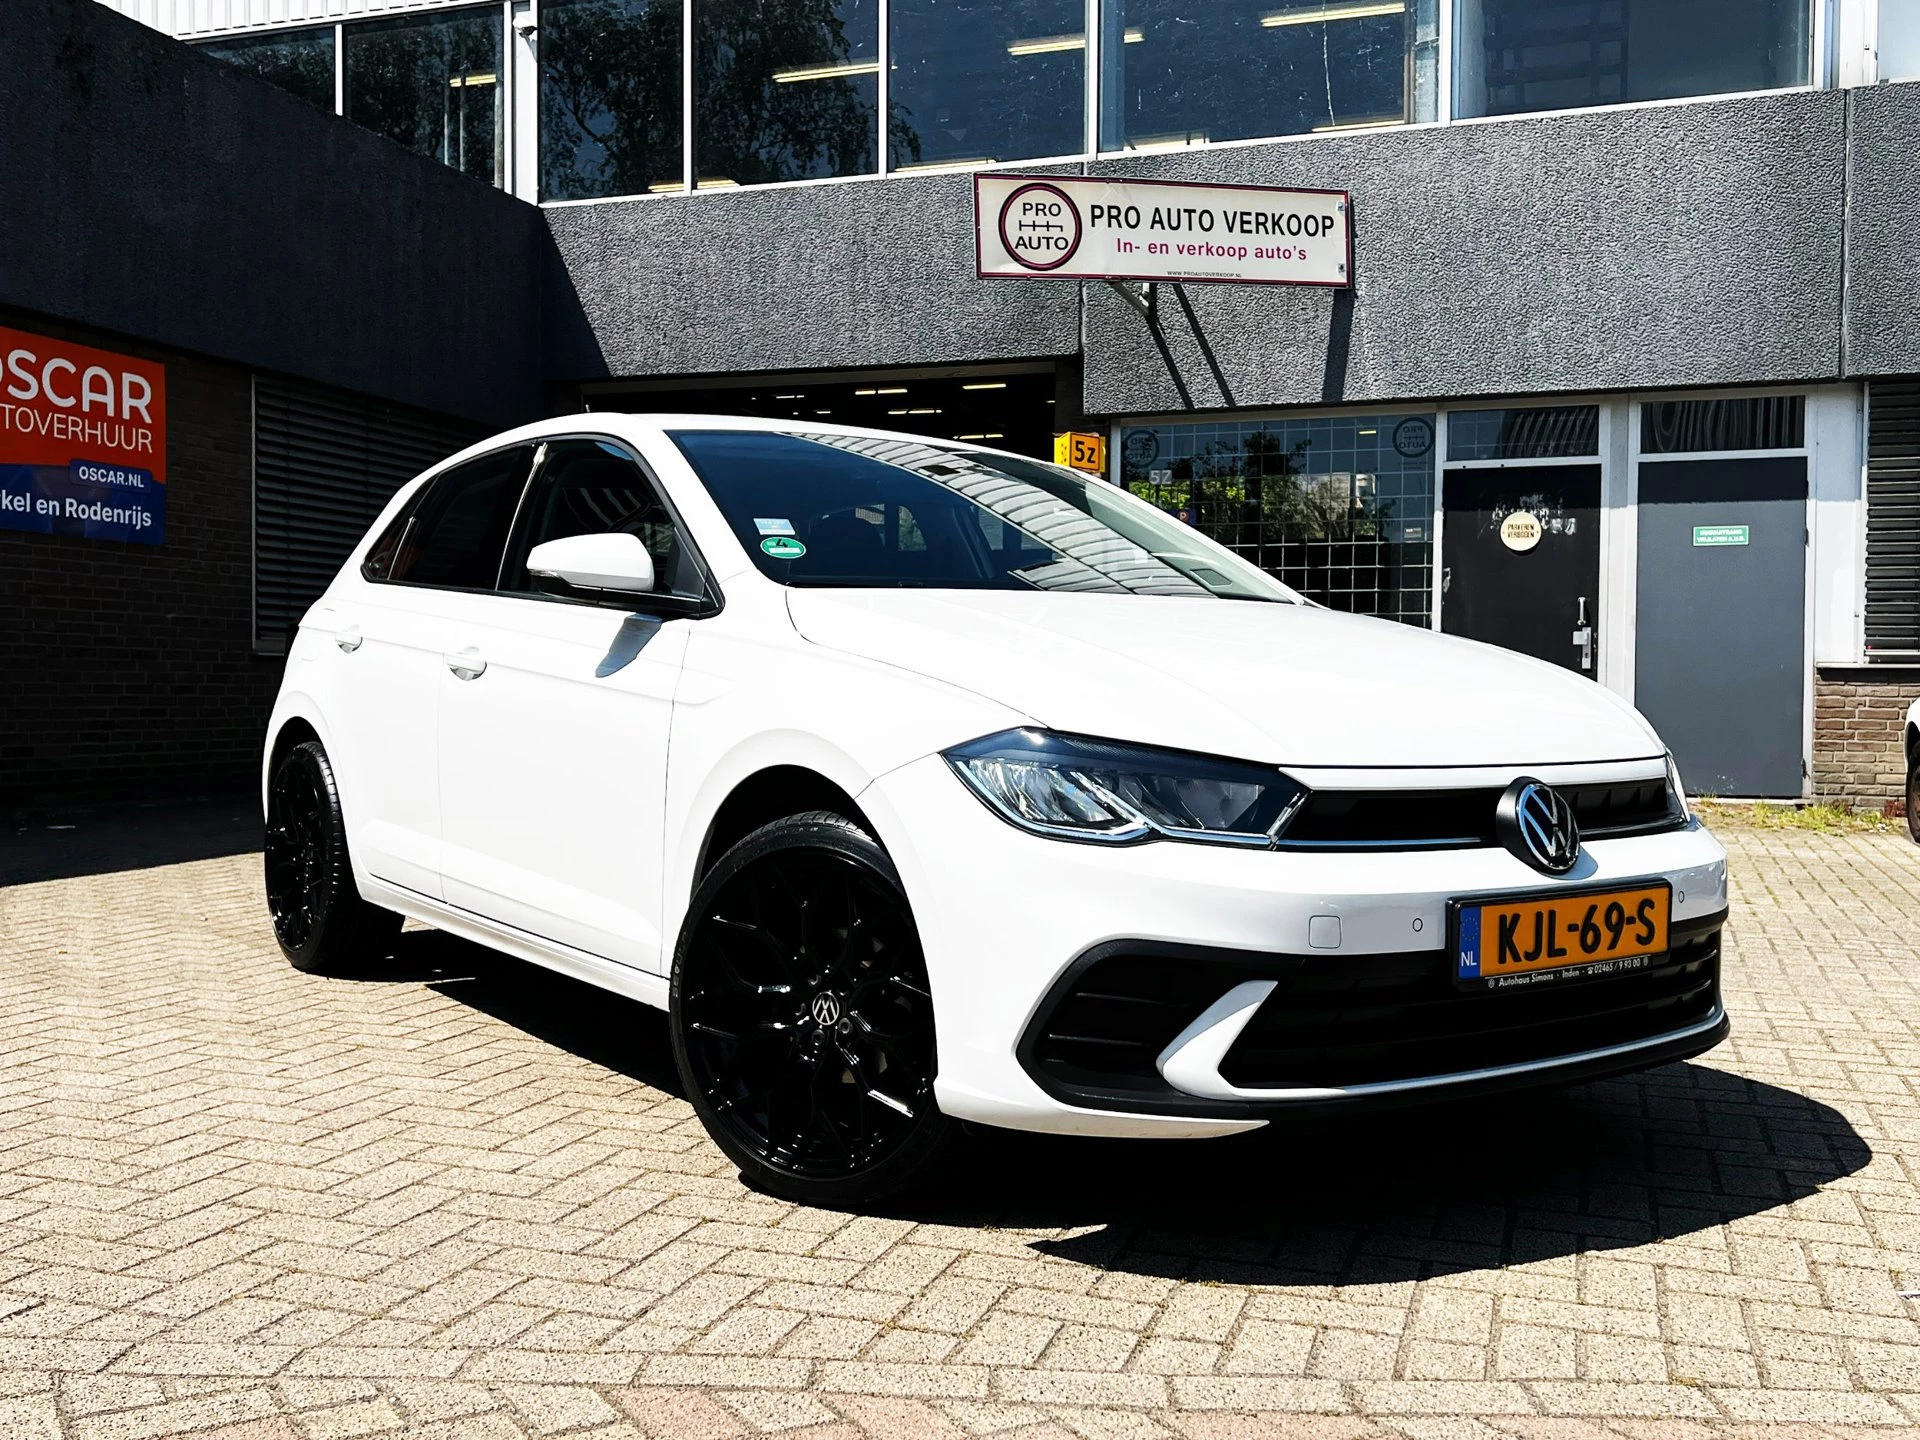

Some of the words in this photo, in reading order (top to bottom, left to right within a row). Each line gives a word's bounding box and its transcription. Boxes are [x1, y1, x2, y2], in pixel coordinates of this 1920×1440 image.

[1022, 202, 1062, 217] PRO
[1090, 204, 1141, 229] PRO
[1150, 207, 1215, 233] AUTO
[1223, 210, 1335, 238] VERKOOP
[1014, 235, 1069, 251] AUTO
[1116, 238, 1141, 253] In-
[1147, 242, 1169, 255] en
[1177, 241, 1247, 261] verkoop
[1254, 245, 1307, 261] auto's
[0, 349, 153, 424] SCAR
[78, 466, 145, 488] OSCAR.NL
[0, 489, 31, 513] kel
[36, 499, 60, 516] en
[65, 498, 152, 530] Rodenrijs
[776, 538, 788, 548] 4
[1497, 898, 1656, 964] KJL-69-S
[1460, 951, 1477, 967] NL
[1498, 976, 1530, 987] Autohaus
[1531, 973, 1554, 983] Simons
[1562, 969, 1580, 978] Inden
